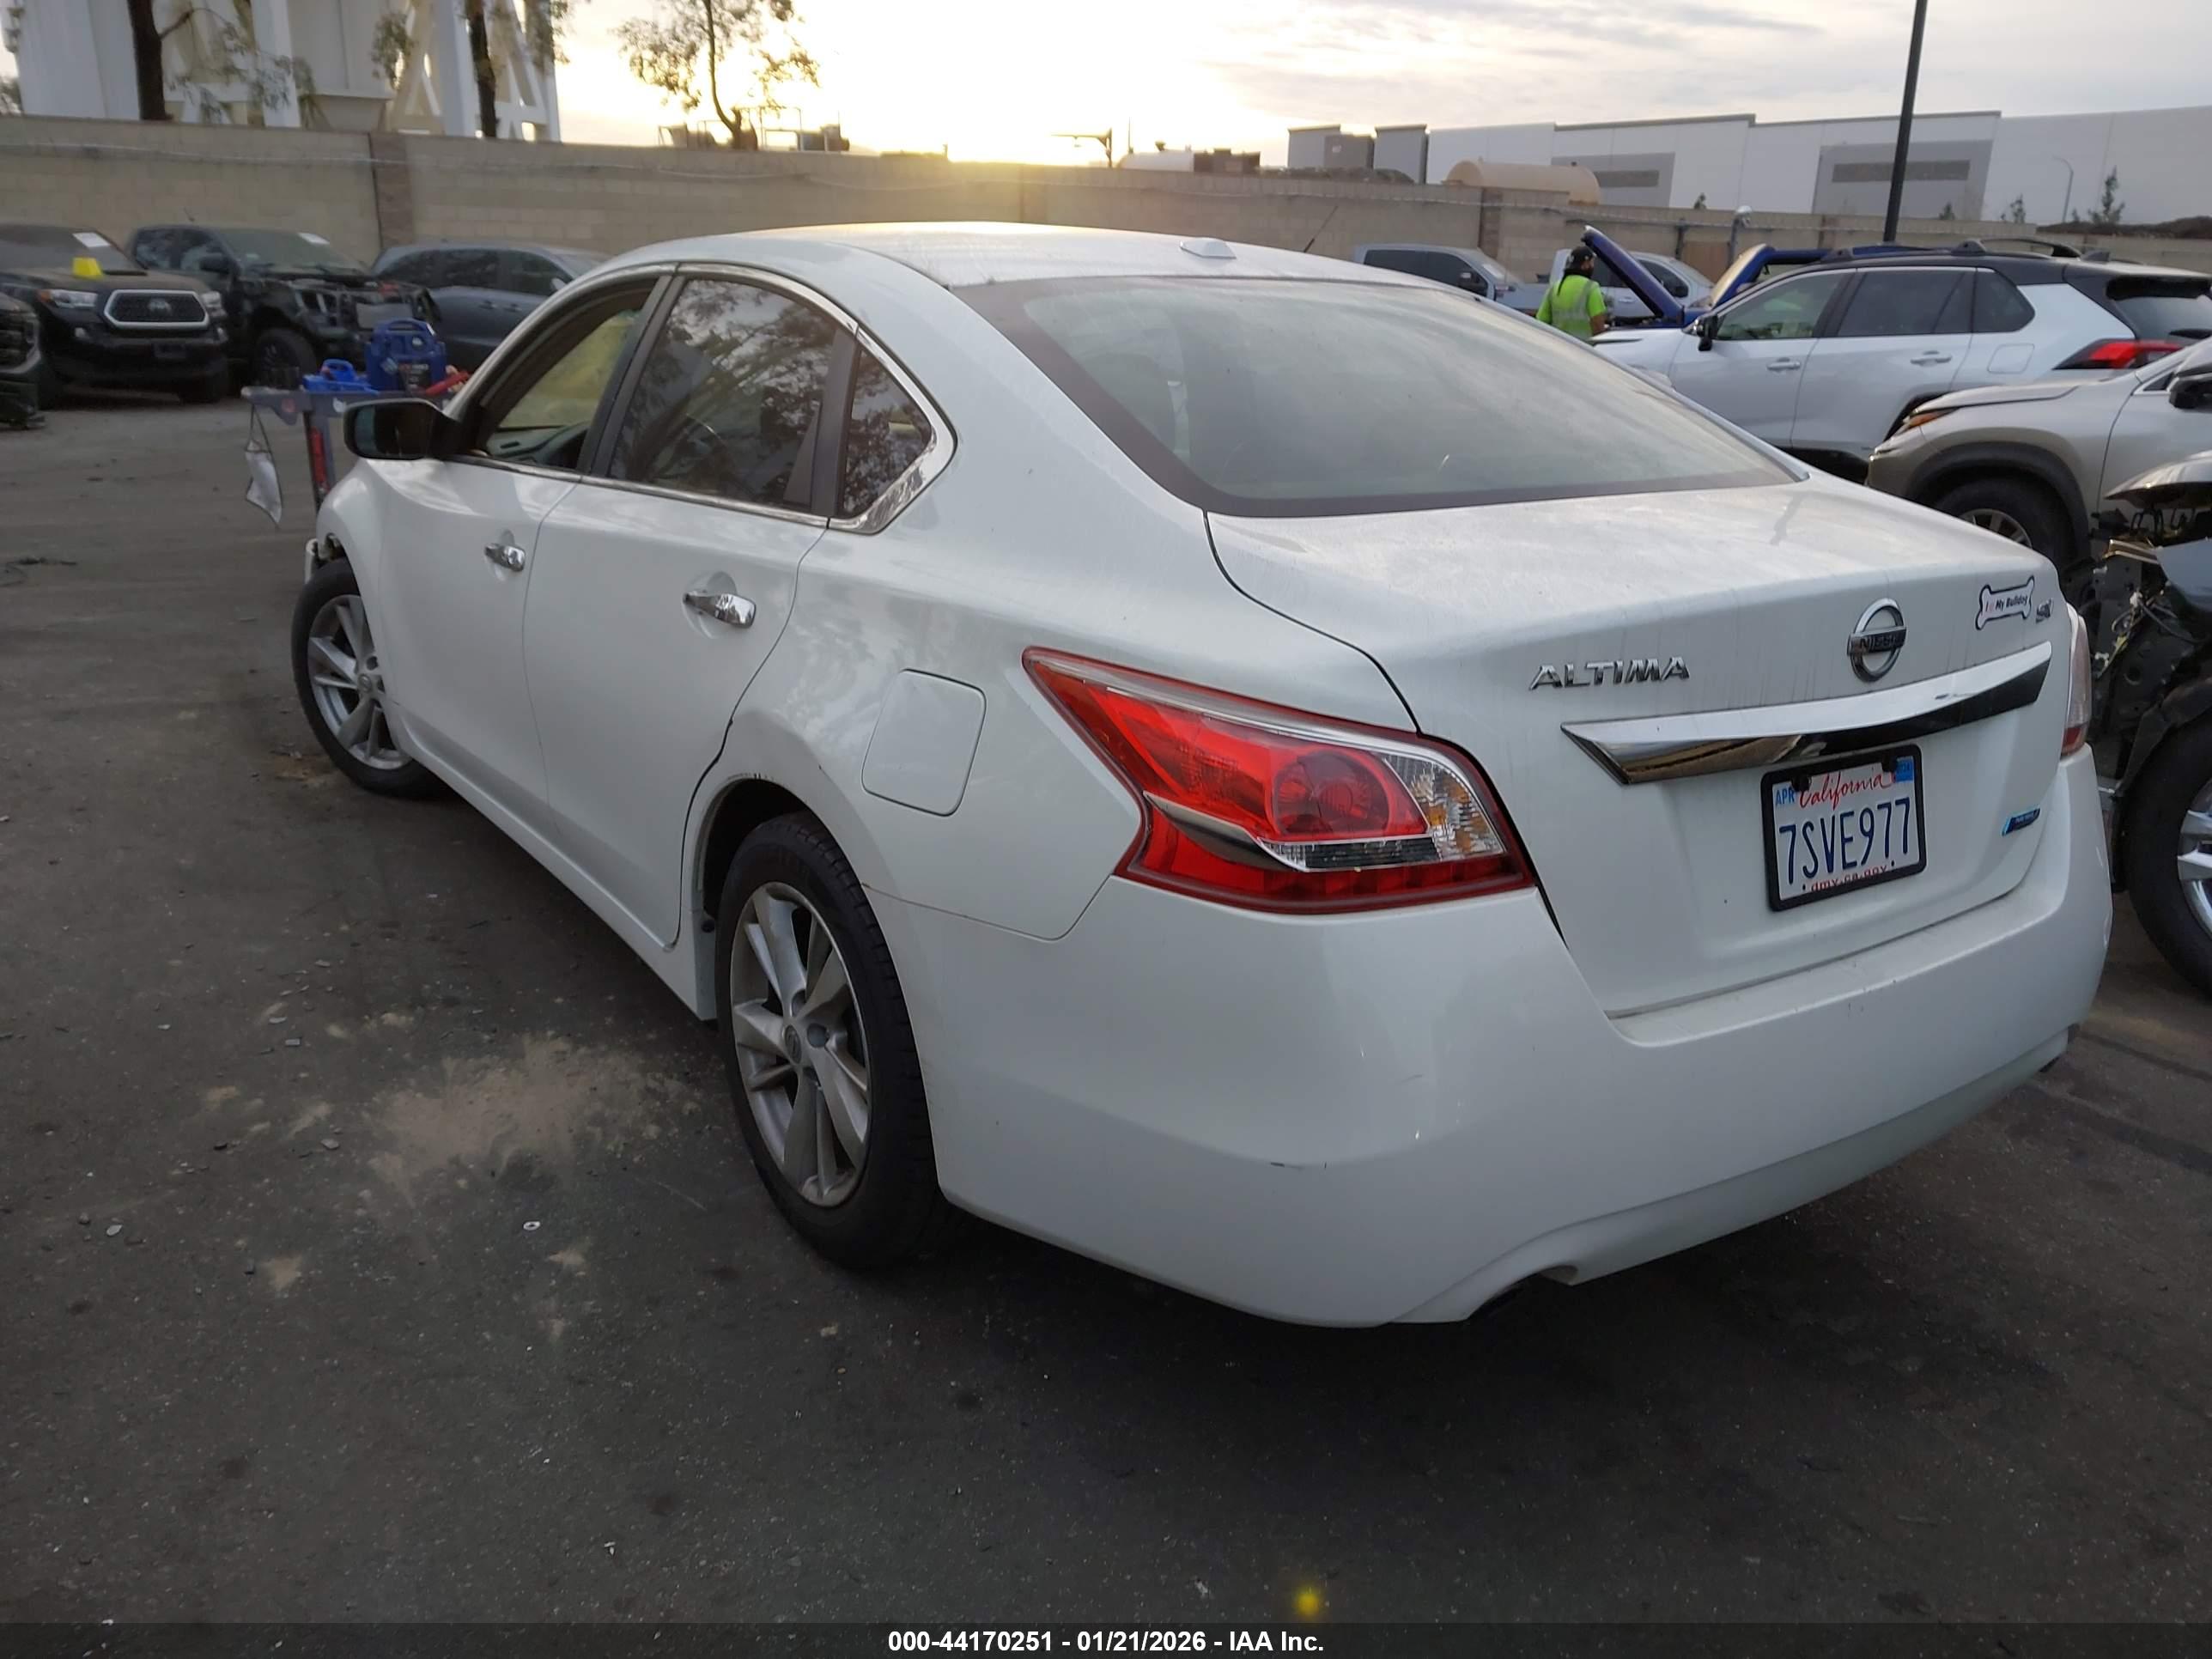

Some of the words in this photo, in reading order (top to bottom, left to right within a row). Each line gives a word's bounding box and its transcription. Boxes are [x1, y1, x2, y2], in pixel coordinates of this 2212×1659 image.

[1528, 656, 1690, 691] ALTIMA
[1775, 788, 1796, 807] APR
[1799, 767, 1891, 811] California
[1778, 796, 1911, 885] 7SVE977
